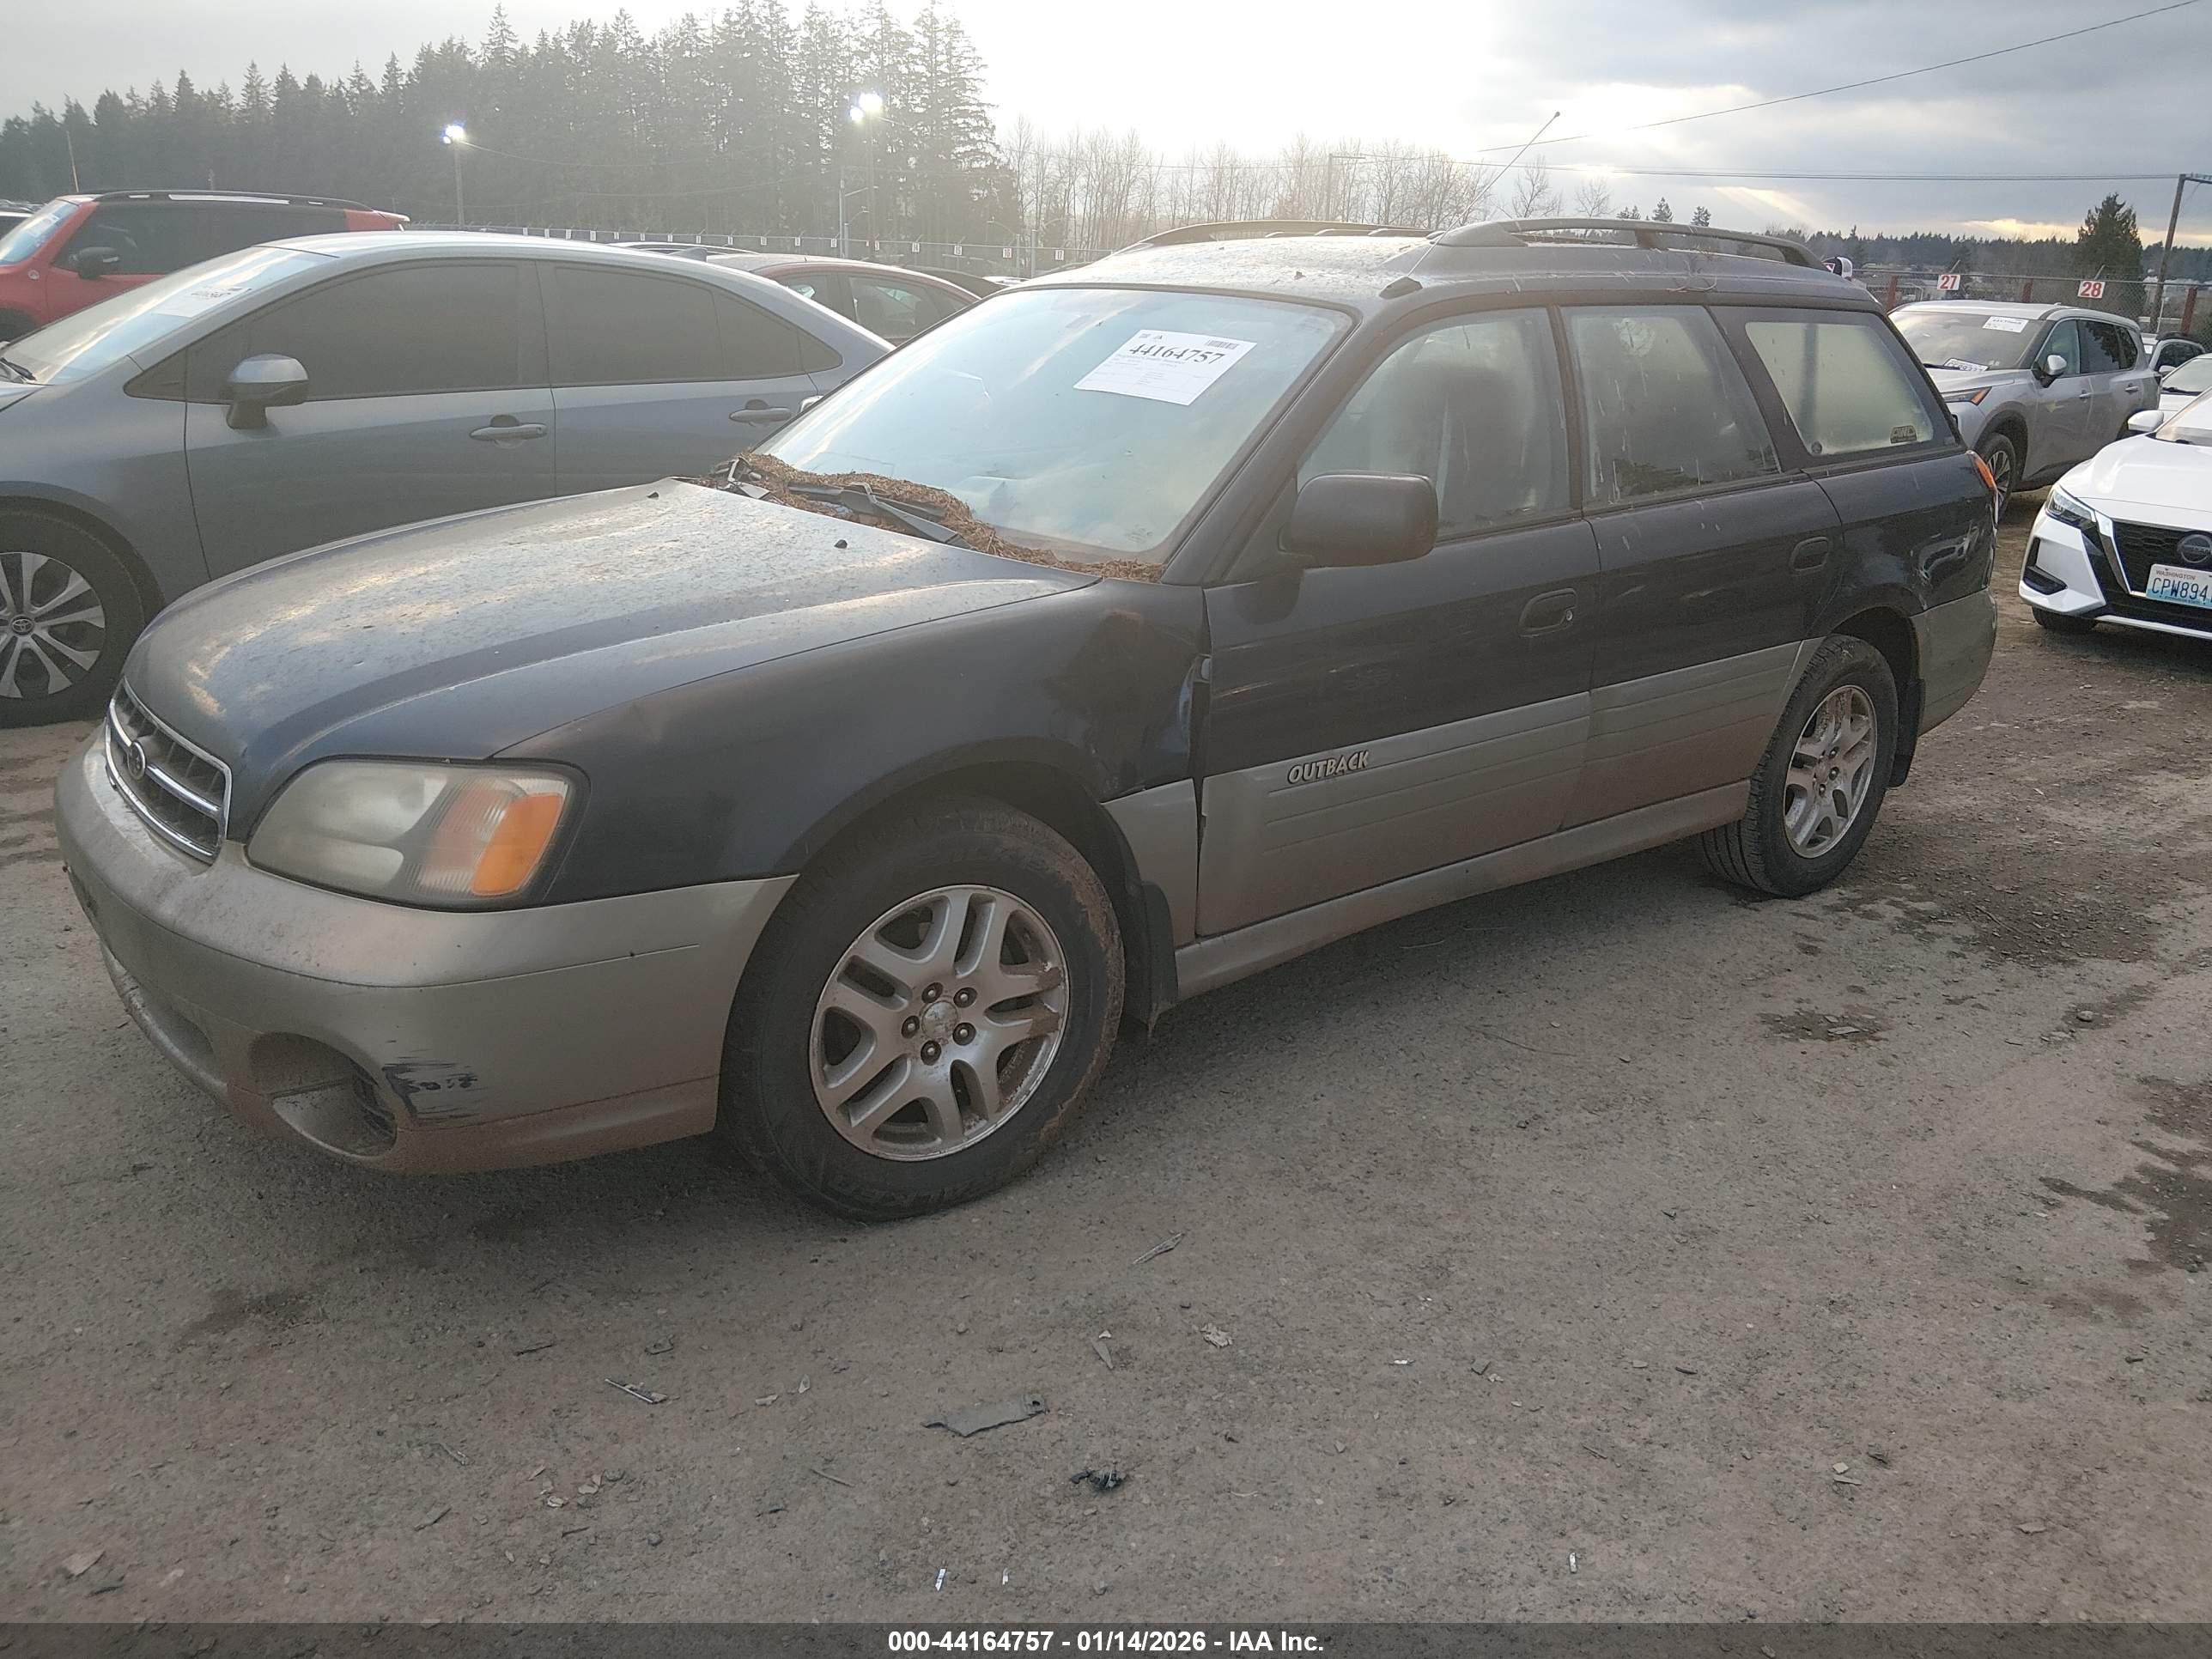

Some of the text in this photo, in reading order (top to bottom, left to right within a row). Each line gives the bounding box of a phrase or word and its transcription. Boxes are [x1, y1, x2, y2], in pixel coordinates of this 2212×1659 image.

[1940, 275, 1957, 289] 27
[2080, 281, 2102, 297] 28
[1129, 343, 1225, 364] 44164757
[2152, 577, 2212, 603] CPW894
[1288, 751, 1369, 784] OUTBACK
